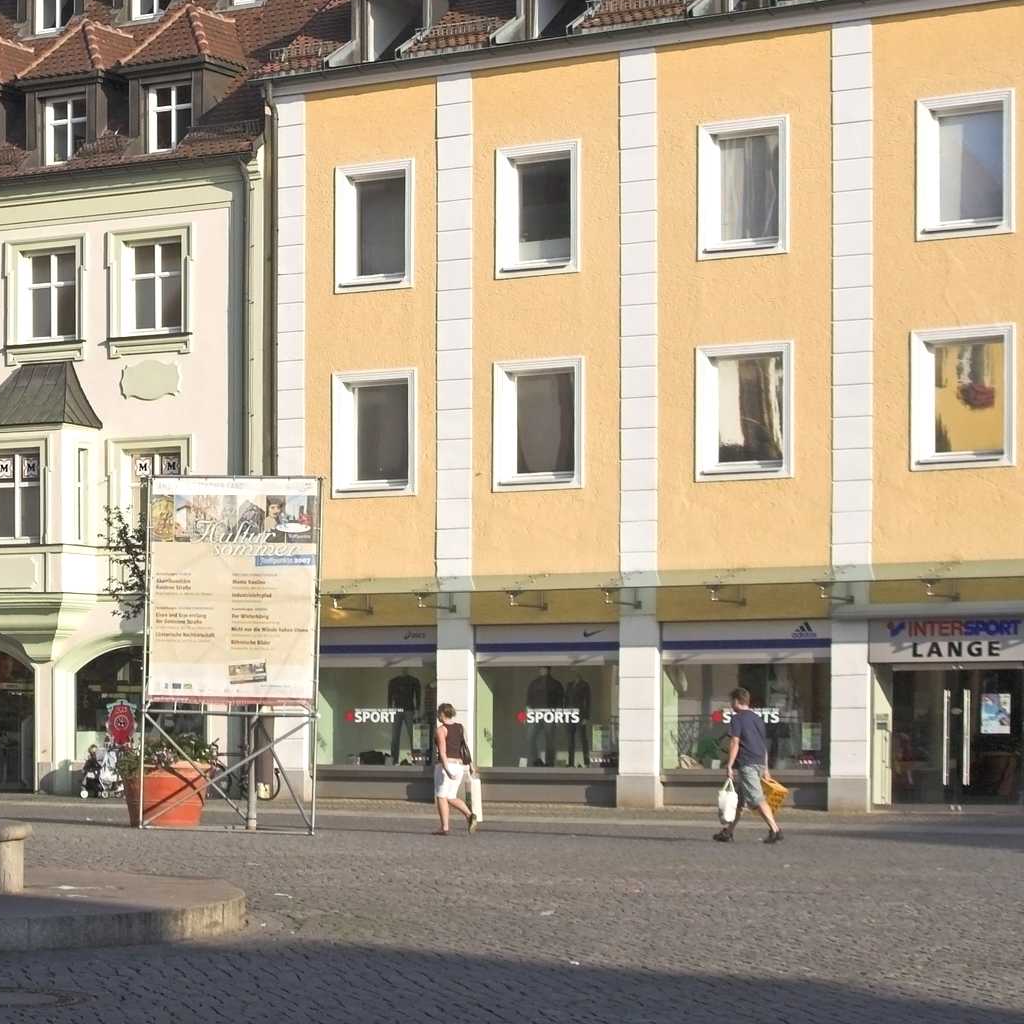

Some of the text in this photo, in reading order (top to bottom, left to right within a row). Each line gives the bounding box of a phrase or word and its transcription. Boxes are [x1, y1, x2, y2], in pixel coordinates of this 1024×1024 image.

[191, 519, 276, 545] Kultur
[907, 619, 1022, 638] INTERSPORT
[912, 640, 1001, 658] LANGE
[354, 711, 396, 723] SPORT
[526, 711, 580, 724] SPORTS
[722, 711, 780, 724] STS
